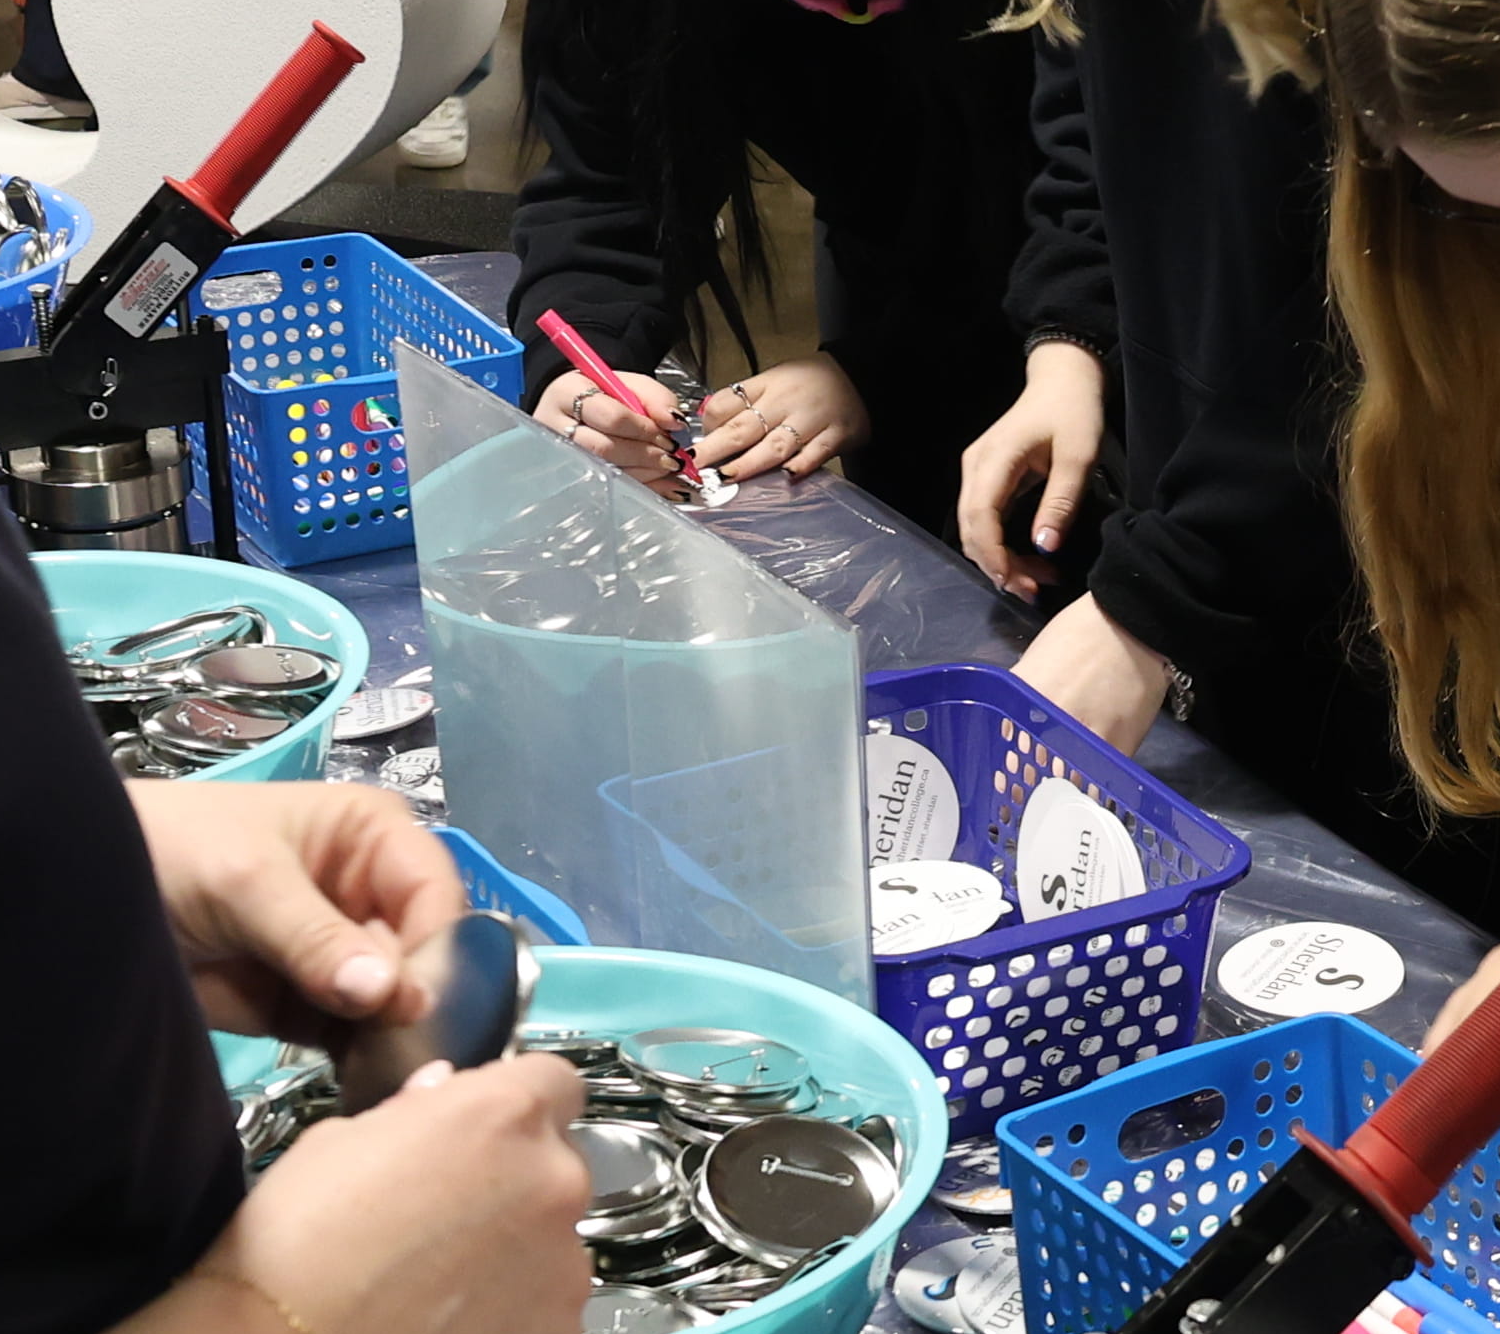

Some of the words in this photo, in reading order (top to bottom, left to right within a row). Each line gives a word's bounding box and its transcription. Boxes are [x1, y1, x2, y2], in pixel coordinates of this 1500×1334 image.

[1041, 874, 1067, 911] S
[1256, 934, 1344, 1000] Sheridan
[1315, 967, 1364, 990] S
